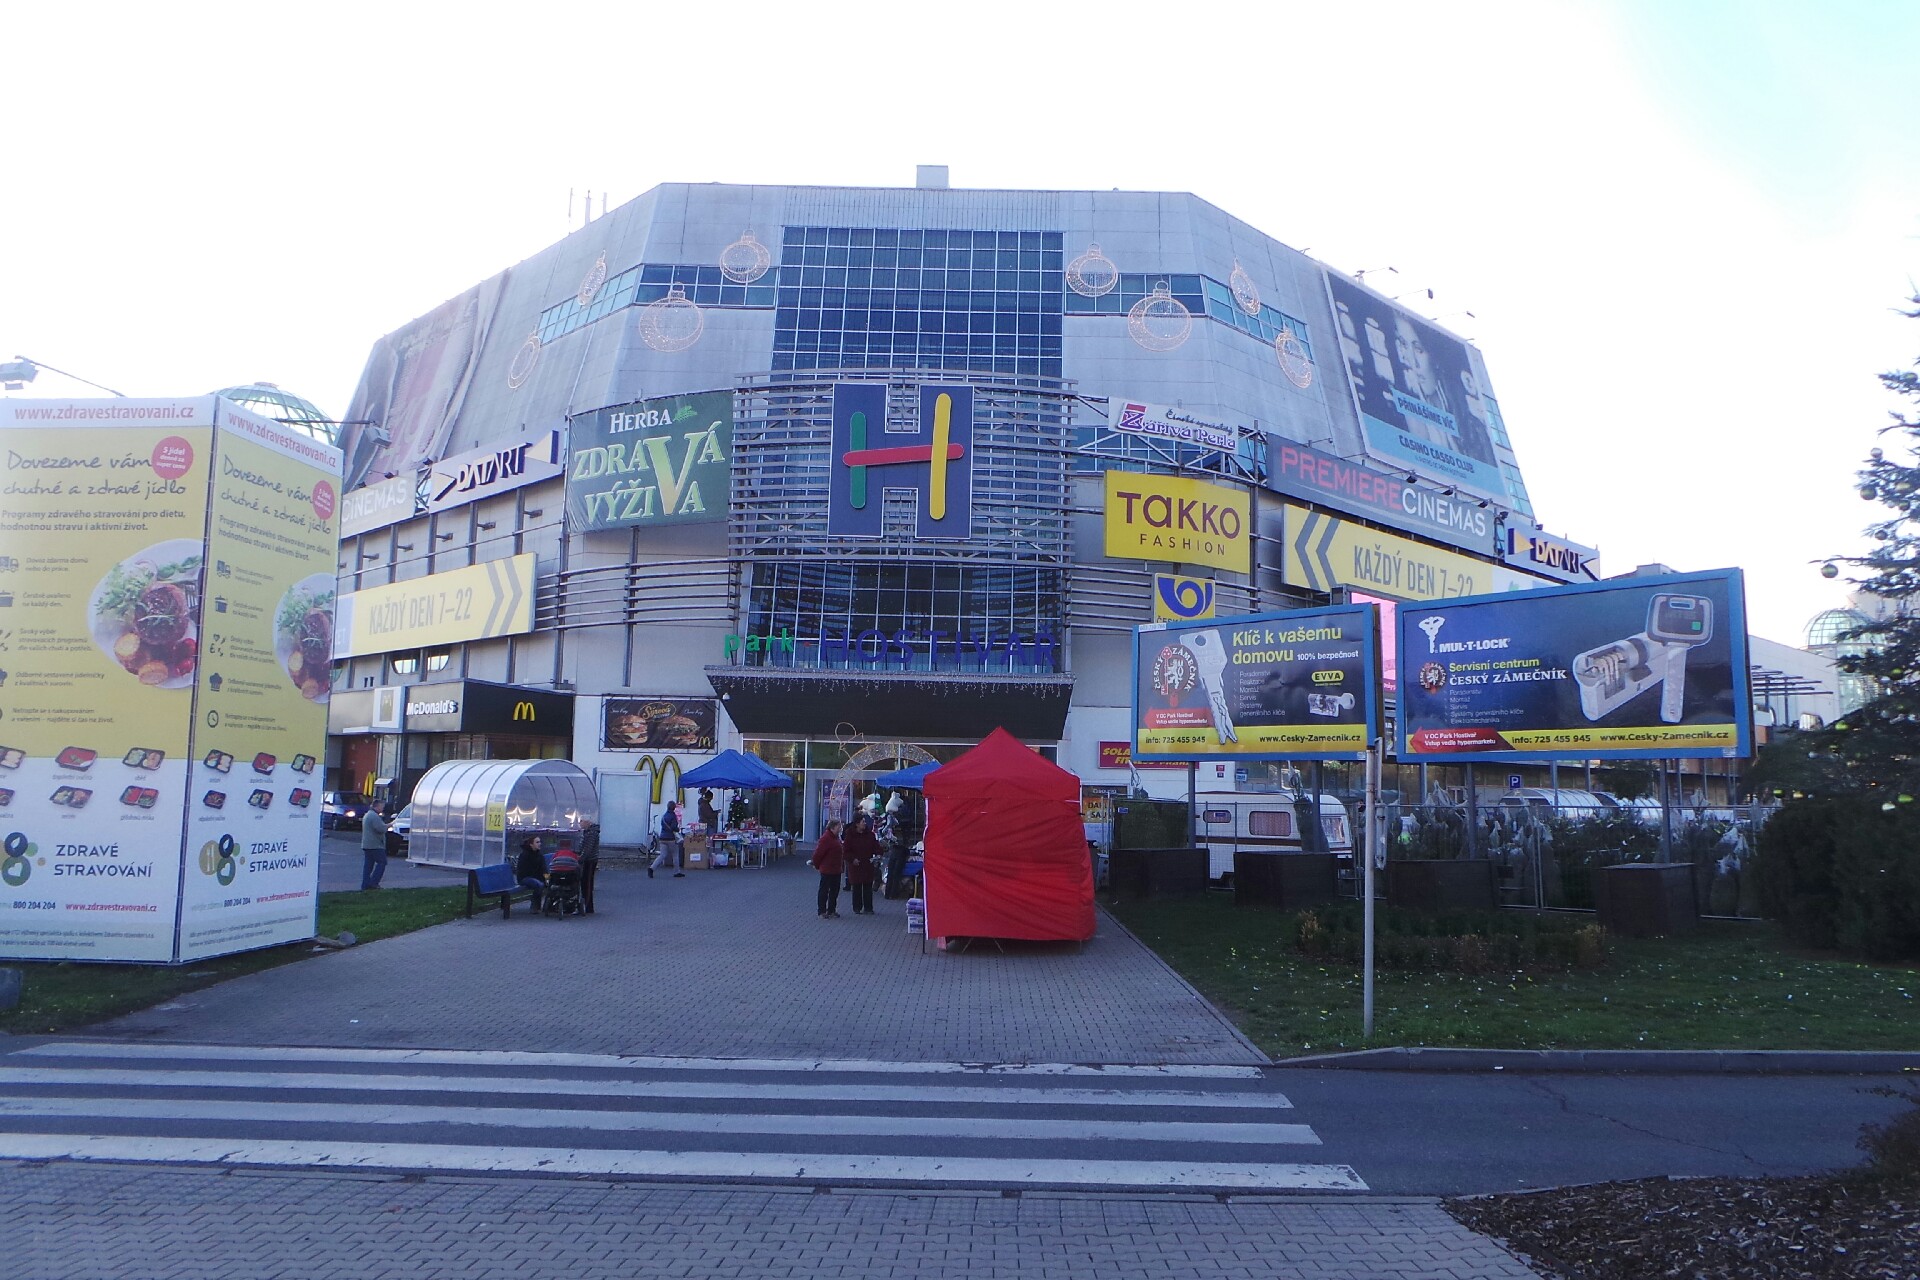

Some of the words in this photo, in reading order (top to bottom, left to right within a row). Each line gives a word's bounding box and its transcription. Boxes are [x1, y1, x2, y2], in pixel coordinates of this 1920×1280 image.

[15, 403, 194, 420] www.zdravestravovani.cz
[609, 408, 673, 434] HERBA
[228, 412, 336, 467] www.zdravestravovani.cz
[1196, 428, 1236, 450] Perla
[8, 450, 102, 470] Dovezeme
[110, 453, 153, 468] vám
[457, 442, 532, 492] DATART
[572, 421, 726, 505] ZDRAVÁ
[3, 478, 62, 495] chutné
[68, 485, 81, 495] a
[88, 478, 140, 495] zdravé
[144, 480, 186, 500] jídlo
[223, 454, 283, 493] Dovezeme
[287, 486, 313, 504] vám
[585, 462, 706, 525] VÝŽIVA
[2, 510, 46, 520] Programy
[47, 510, 92, 519] zdravého
[93, 509, 140, 518] stravování
[142, 511, 158, 520] pro
[221, 488, 259, 511] chutné
[262, 506, 271, 515] a
[274, 505, 306, 526] zdravé
[308, 516, 331, 534] jídlo
[0, 522, 51, 531] hodnotnou
[53, 523, 83, 531] stravu
[90, 522, 122, 531] aktivní
[1140, 533, 1225, 556] FASHION
[1353, 544, 1402, 588] KAŽDÝ
[1407, 561, 1435, 596] DEN
[369, 593, 406, 636] KAŽDÝ
[409, 600, 434, 627] DEN
[723, 627, 794, 660] park
[821, 625, 1055, 666] HOSTIVAŘ
[1232, 629, 1261, 647] Klíč
[1265, 630, 1275, 644] k
[1278, 626, 1342, 643] vašemu
[1232, 648, 1294, 665] domovu
[1296, 652, 1316, 661] 100%
[1317, 650, 1359, 661] bezpečnost
[1449, 660, 1491, 672] Servisní
[1493, 658, 1540, 670] centrum
[1314, 671, 1341, 681] EVVA
[1450, 672, 1489, 686] ČESKÝ
[1492, 667, 1568, 684] ZÁMEČNÍK
[406, 700, 456, 716] McDonald's
[1162, 736, 1175, 744] 725
[1259, 734, 1361, 744] www.Cesky-Zamecnik.cz
[1512, 736, 1532, 744] info:
[1553, 735, 1571, 743] 455
[1600, 731, 1729, 742] www.Cesky-Zamecnik.cz
[56, 842, 119, 857] ZDRAVÉ
[250, 839, 288, 855] ZDRAVÉ
[54, 862, 153, 878] STRAVOVÁNÍ
[249, 853, 308, 873] STRAVOVÁNÍ
[13, 900, 27, 909] 800
[28, 901, 41, 909] 204
[42, 901, 56, 910] 204
[66, 902, 157, 912] www.zdravestravovani.cz
